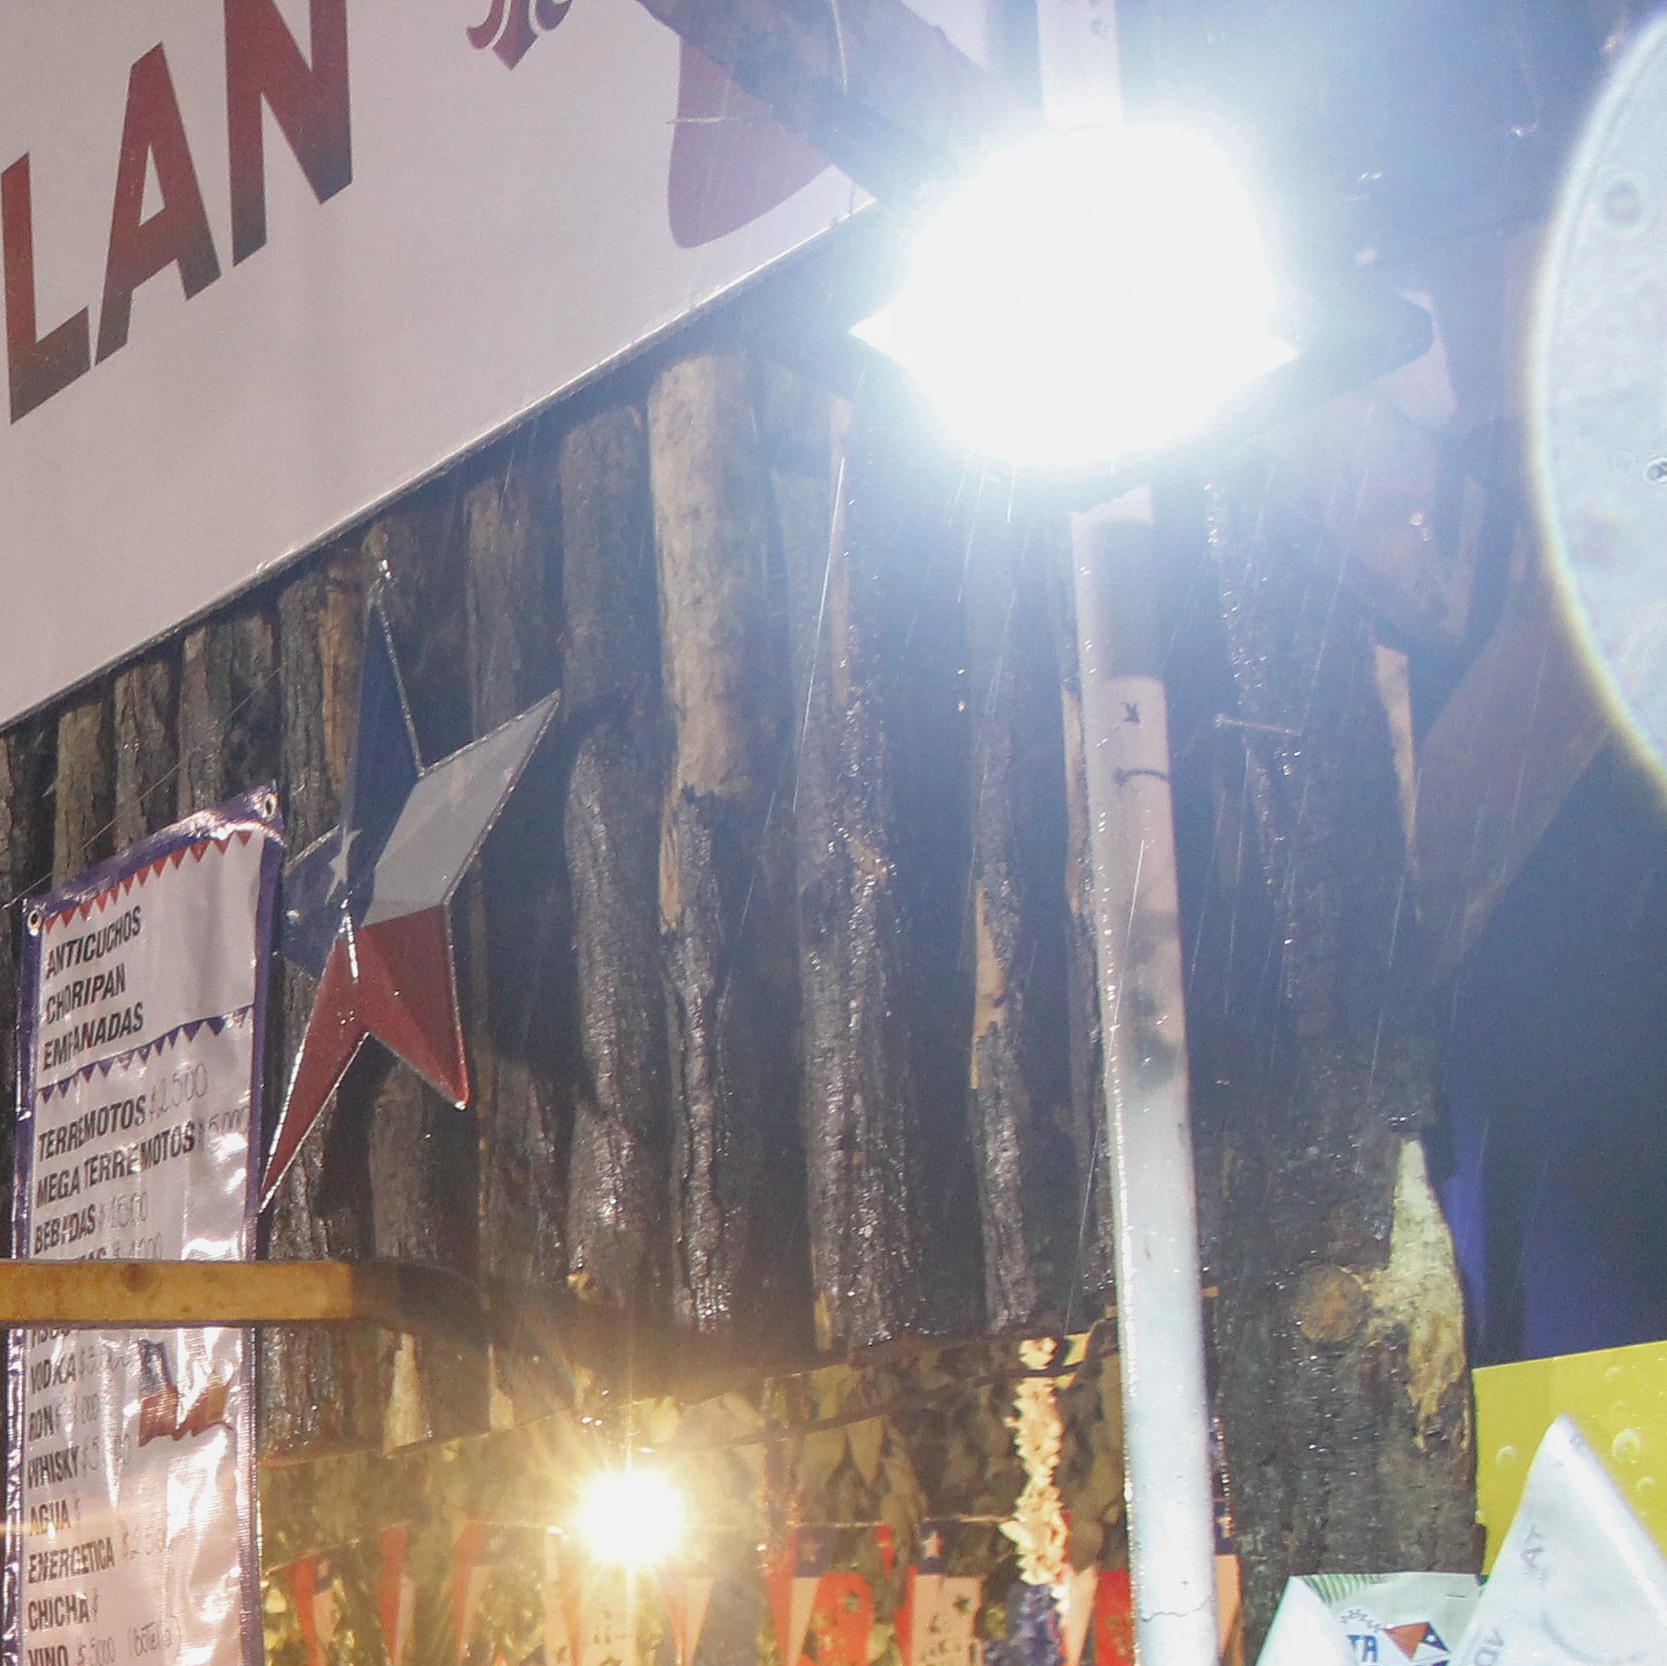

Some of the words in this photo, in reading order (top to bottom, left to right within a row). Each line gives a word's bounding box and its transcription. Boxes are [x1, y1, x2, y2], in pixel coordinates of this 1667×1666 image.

[46, 905, 142, 980] ANTICUCHOS
[45, 963, 126, 1025] CHORIPAN
[43, 1002, 144, 1071] EMPANADAS
[38, 1094, 147, 1162] TERREMOTOS
[36, 1166, 81, 1209] MEGA
[84, 1120, 196, 1189] TERREMOTOS
[34, 1204, 96, 1255] BEBIDAS
[27, 1445, 80, 1489] WHISKY
[27, 1594, 90, 1632] CHICHA
